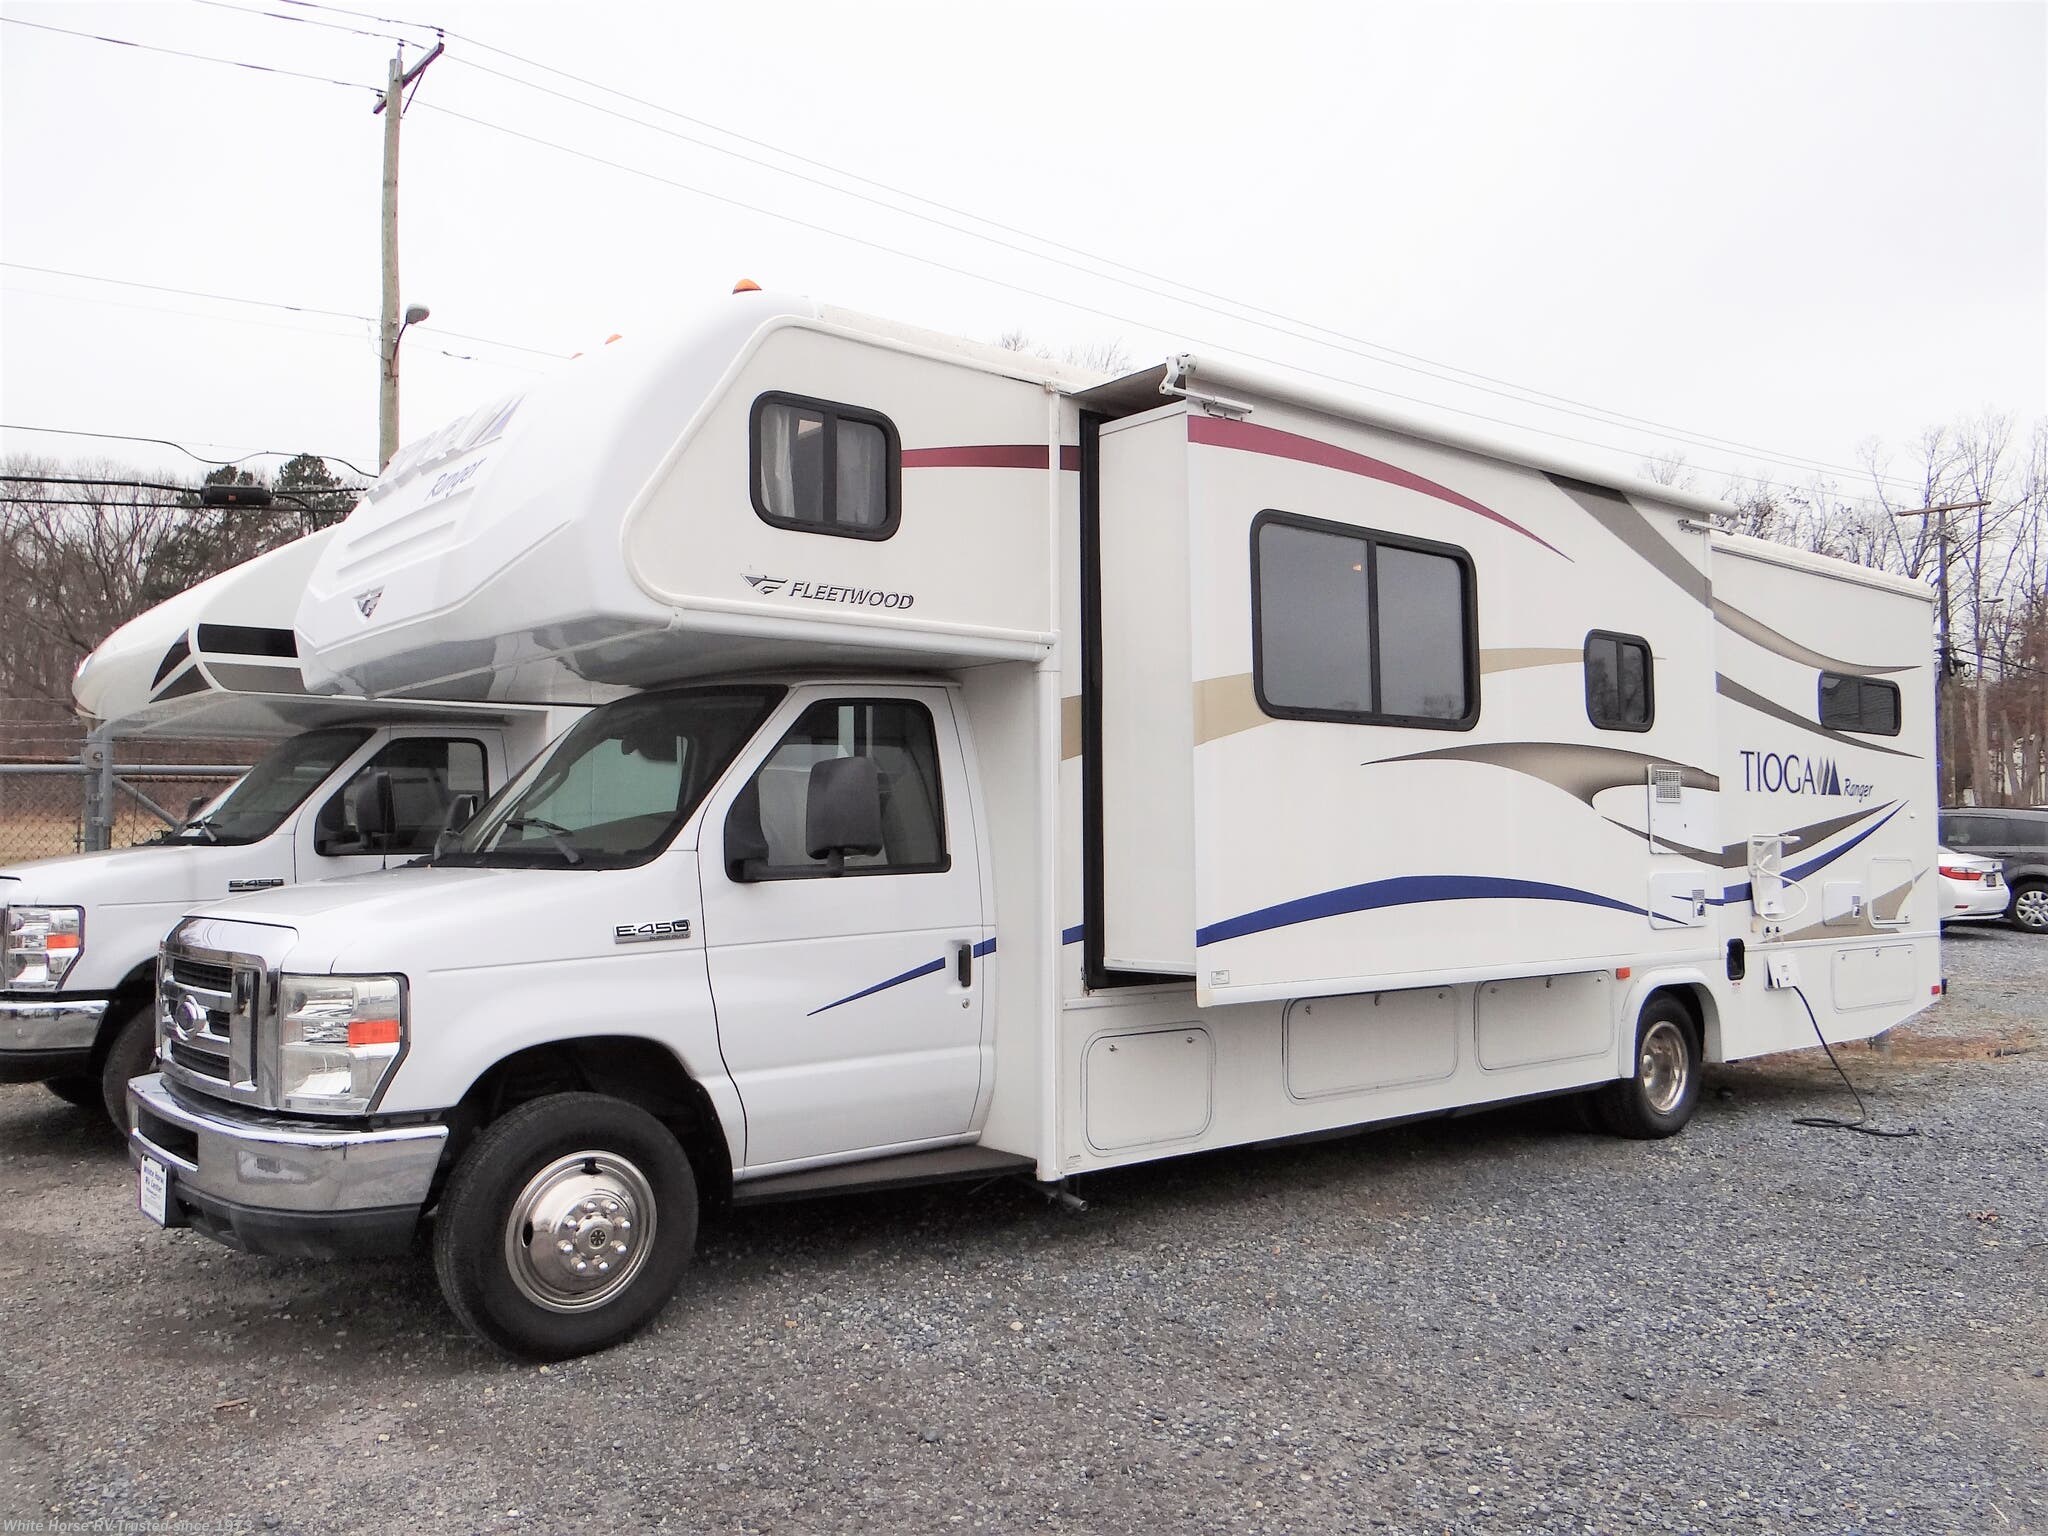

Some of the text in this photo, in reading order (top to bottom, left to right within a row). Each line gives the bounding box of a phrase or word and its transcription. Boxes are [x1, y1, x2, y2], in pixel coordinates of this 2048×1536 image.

[789, 582, 914, 609] FLEETWOOD
[1740, 750, 1874, 803] TIOGA Ranger
